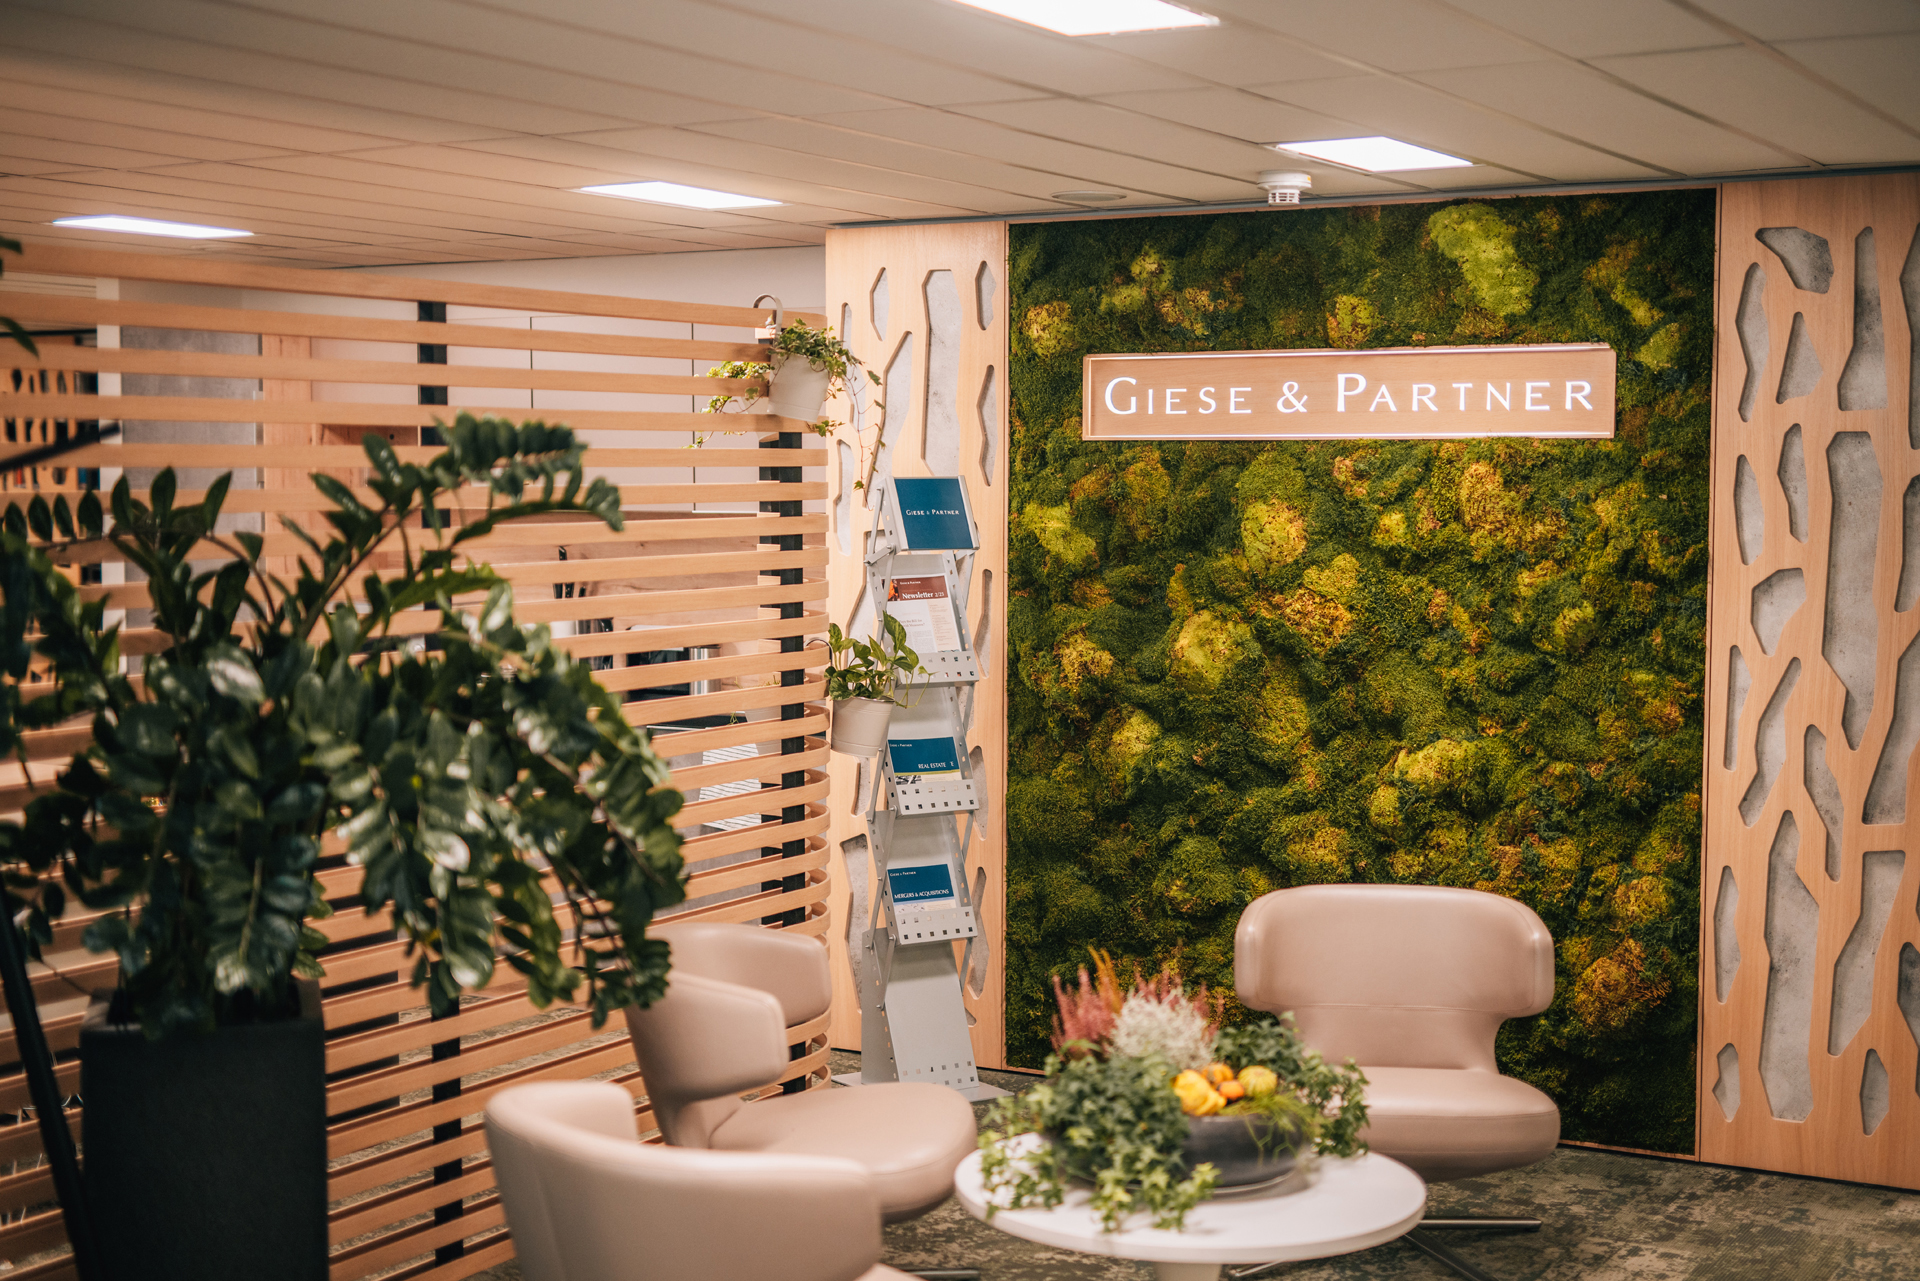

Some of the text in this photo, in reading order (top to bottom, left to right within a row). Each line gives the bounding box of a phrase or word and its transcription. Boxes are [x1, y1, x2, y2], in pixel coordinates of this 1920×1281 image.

[1104, 373, 1594, 415] GIESE & PARTNER
[902, 591, 934, 599] Newsletter
